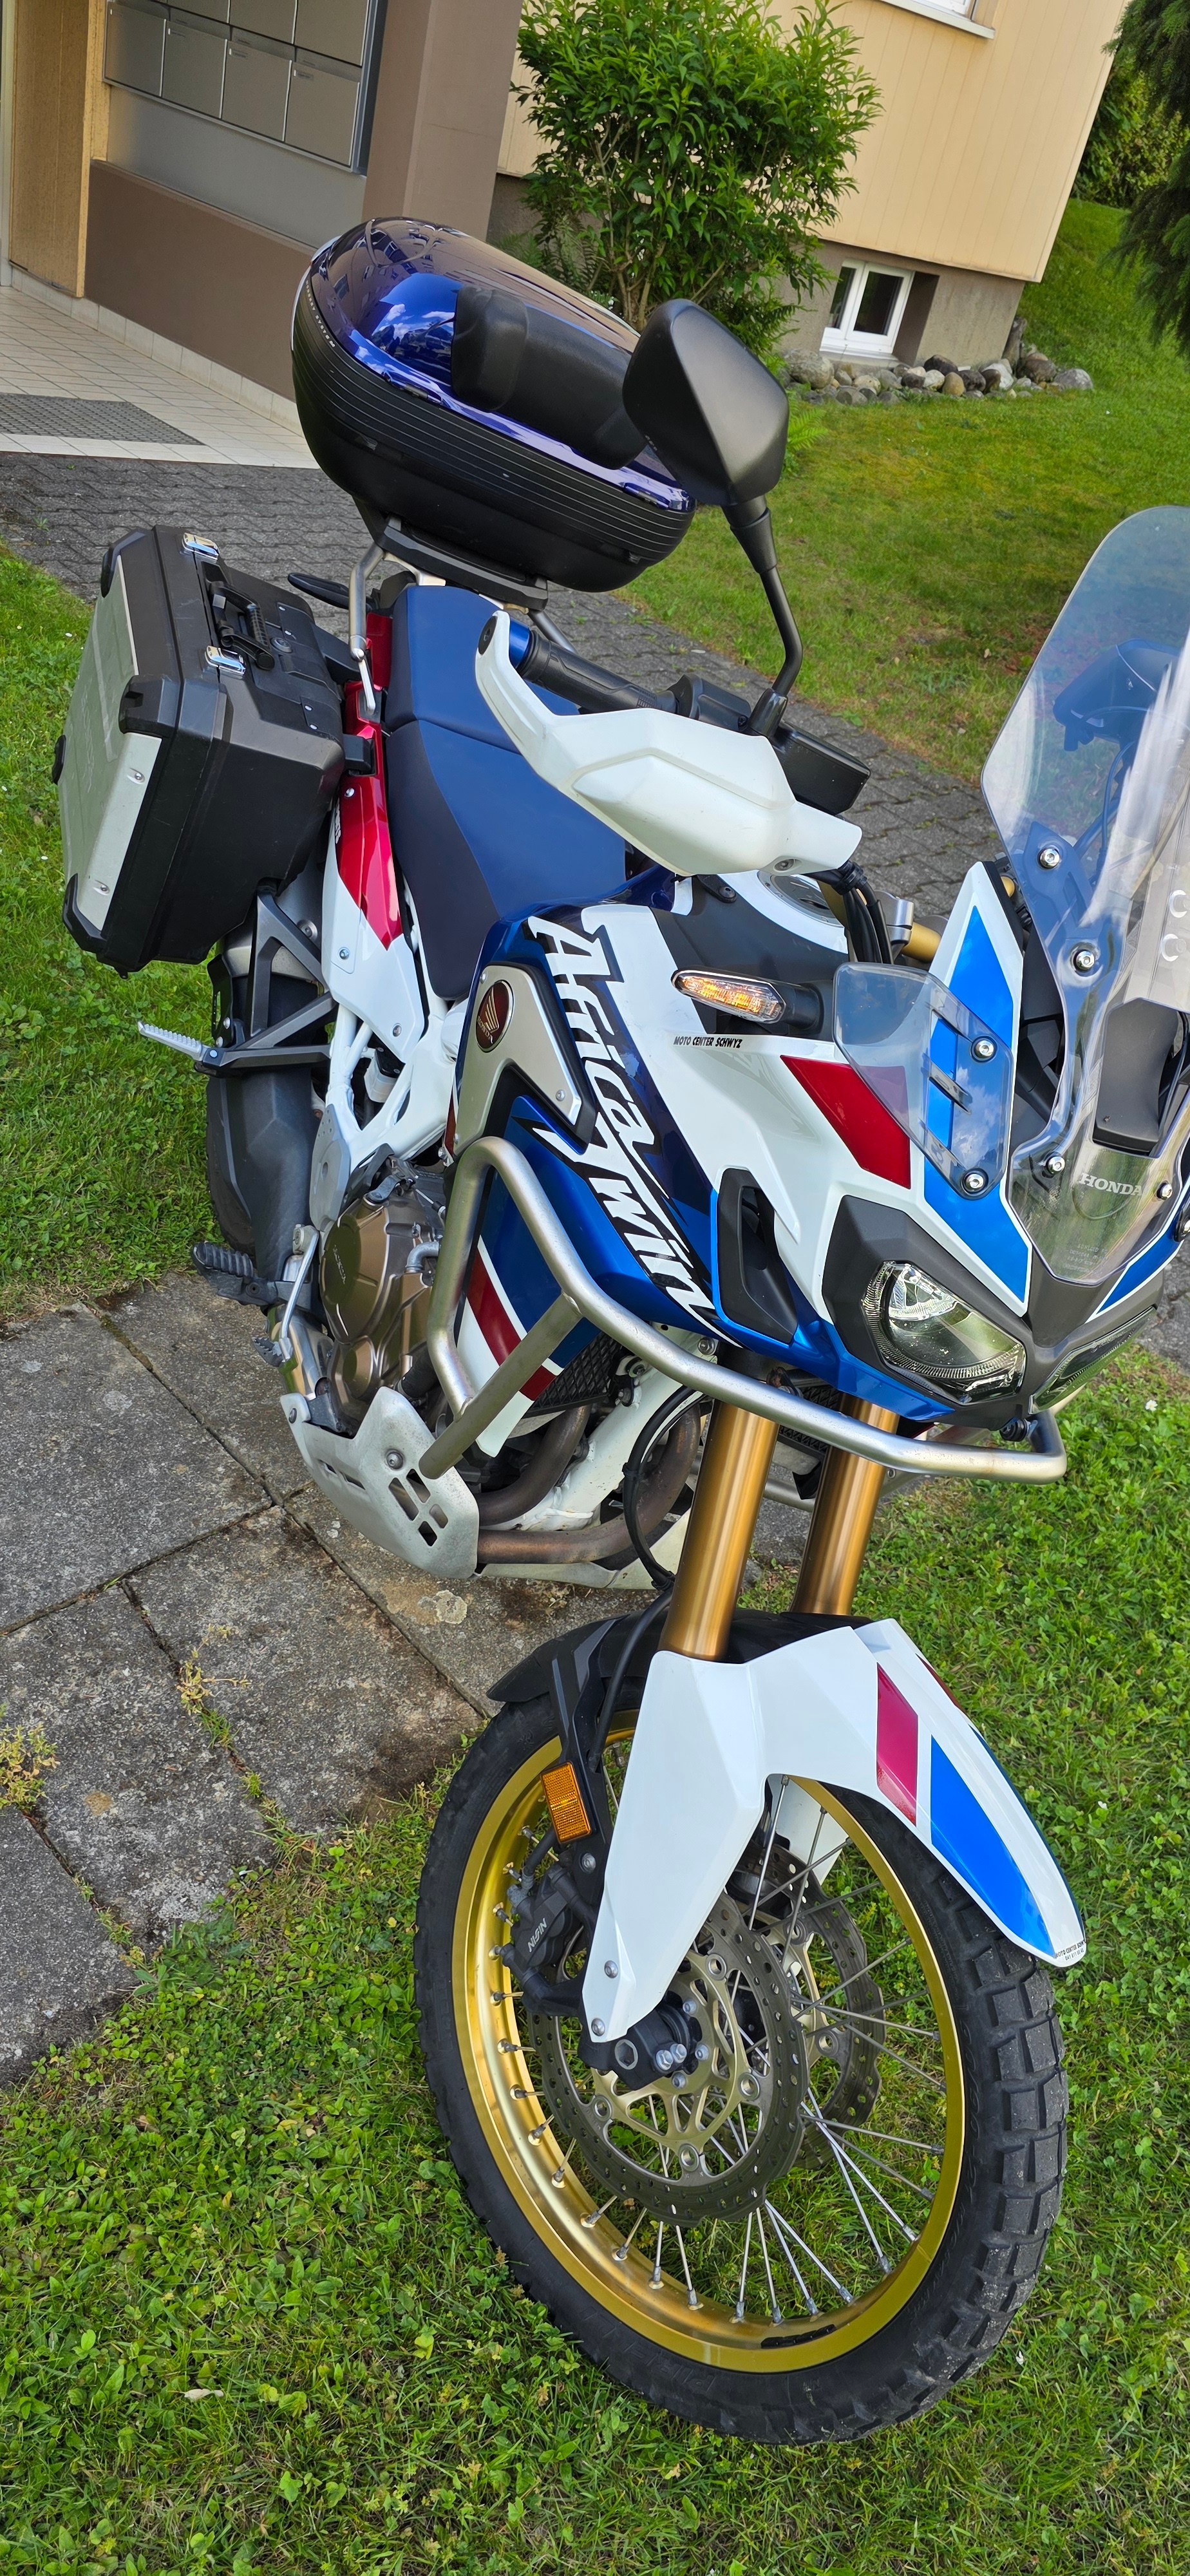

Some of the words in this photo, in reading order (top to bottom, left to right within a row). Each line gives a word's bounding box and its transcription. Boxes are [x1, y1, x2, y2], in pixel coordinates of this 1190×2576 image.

[527, 915, 669, 1199] Africa
[674, 1036, 692, 1046] MOTO
[692, 1036, 714, 1046] CENTER
[715, 1037, 742, 1048] SCHWYZ
[1079, 1173, 1142, 1196] HONDA
[532, 1112, 744, 1349] Twin
[528, 1917, 547, 1953] NISSIN
[580, 2304, 716, 2393] PIRELLI
